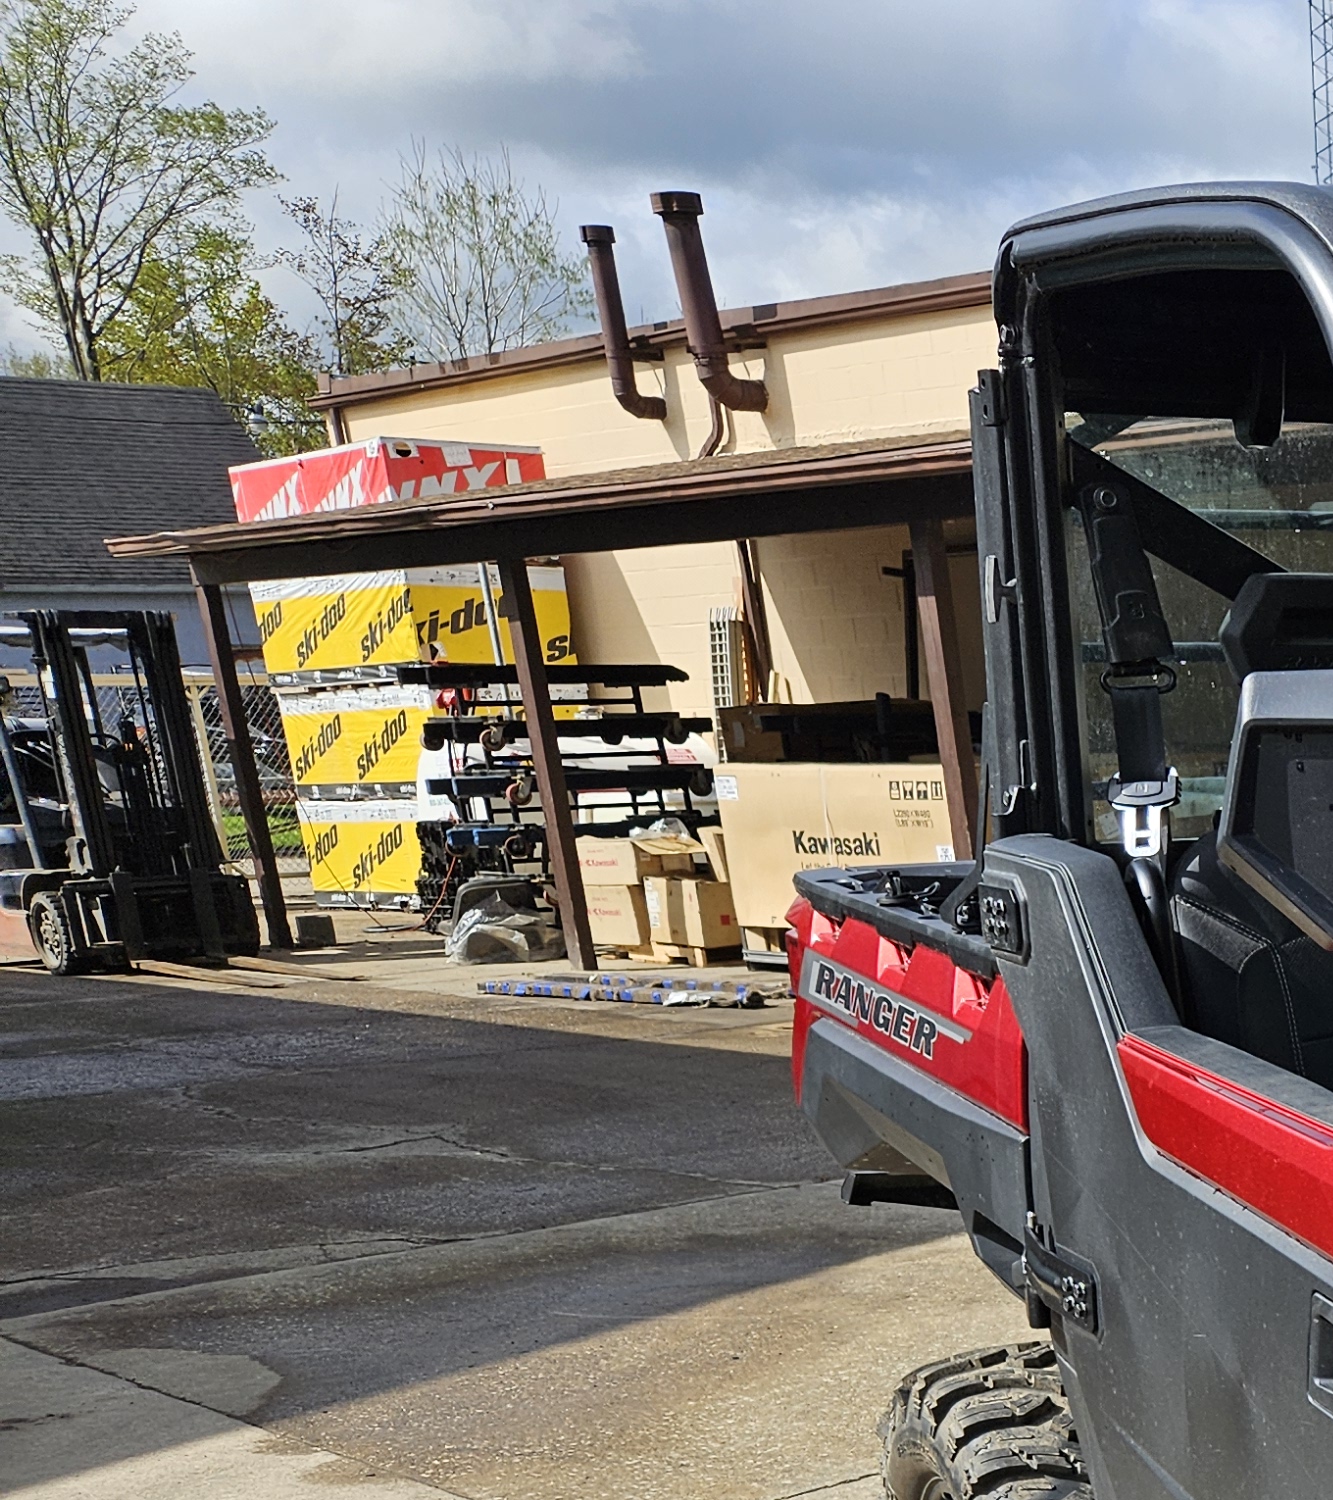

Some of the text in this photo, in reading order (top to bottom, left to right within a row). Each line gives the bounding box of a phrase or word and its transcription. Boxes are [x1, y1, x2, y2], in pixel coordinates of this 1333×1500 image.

[296, 594, 346, 668] ski-doo
[295, 713, 342, 782] ski-doo
[356, 709, 407, 781] ski-doo
[353, 823, 403, 889] ski-doo
[792, 830, 881, 856] Kawasaki
[814, 960, 939, 1061] RANGER
